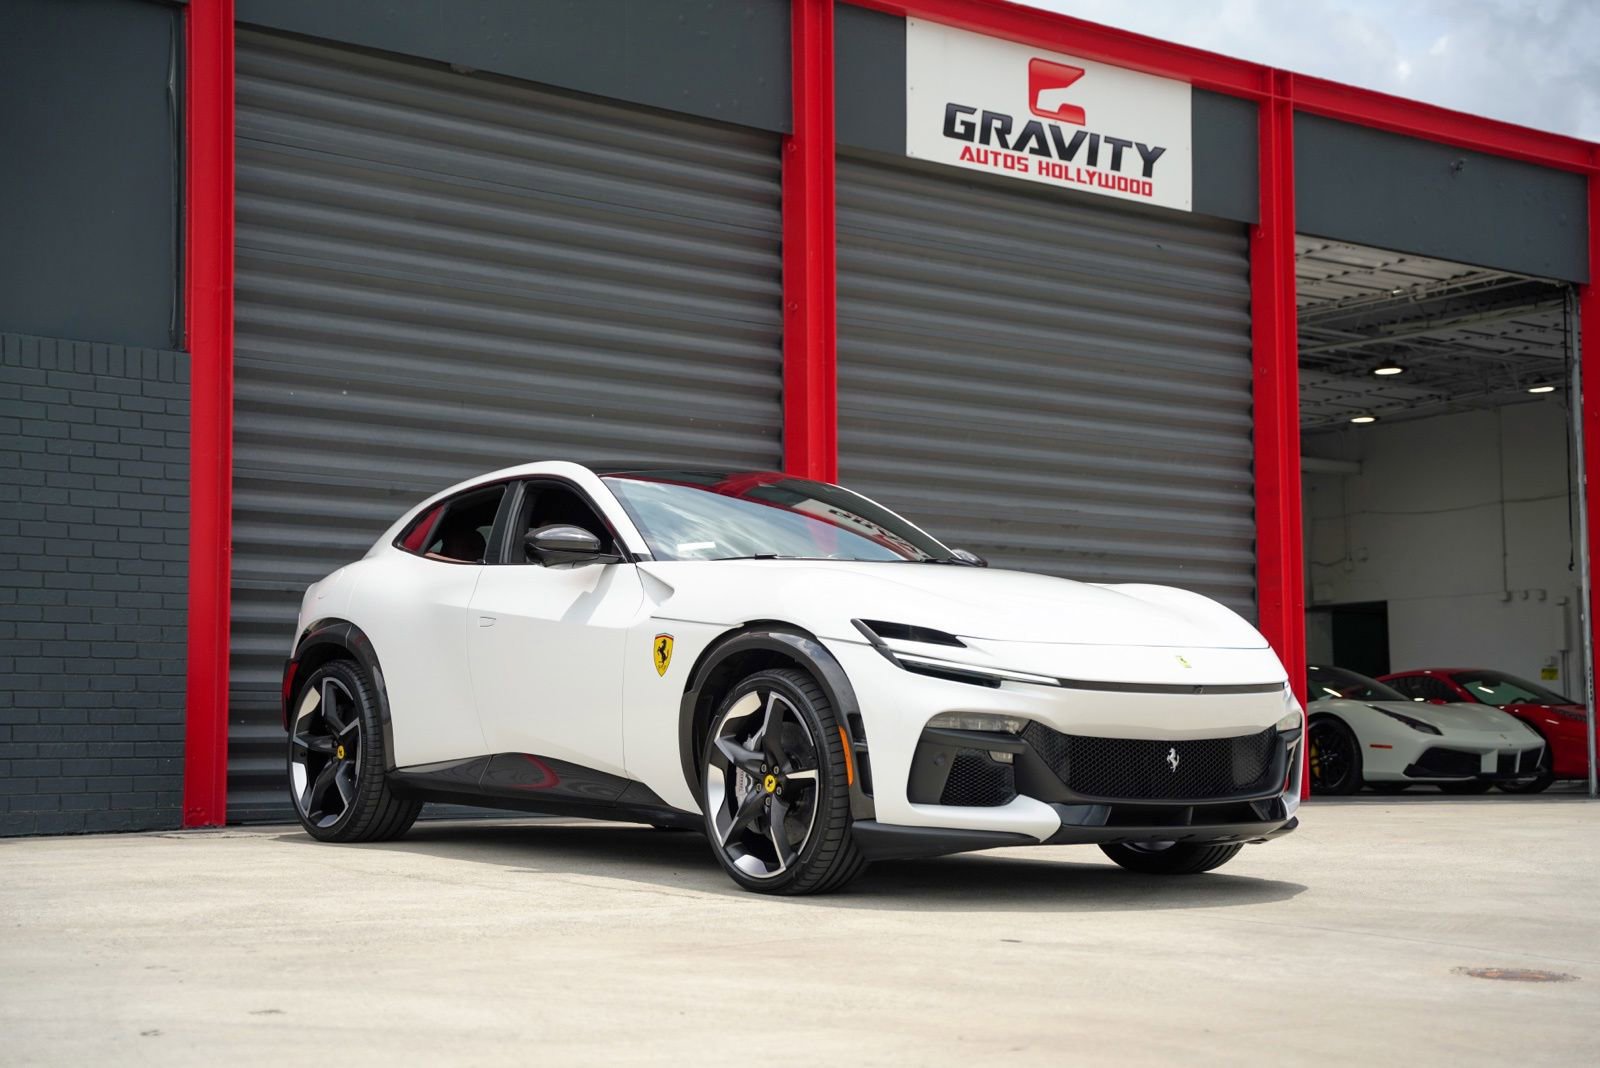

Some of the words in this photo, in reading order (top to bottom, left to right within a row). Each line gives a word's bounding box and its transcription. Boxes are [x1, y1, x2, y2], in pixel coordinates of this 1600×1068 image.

[943, 102, 1166, 178] GRAVITY
[960, 145, 1029, 172] AUTOS
[1038, 160, 1153, 197] HOLLYWOOD
